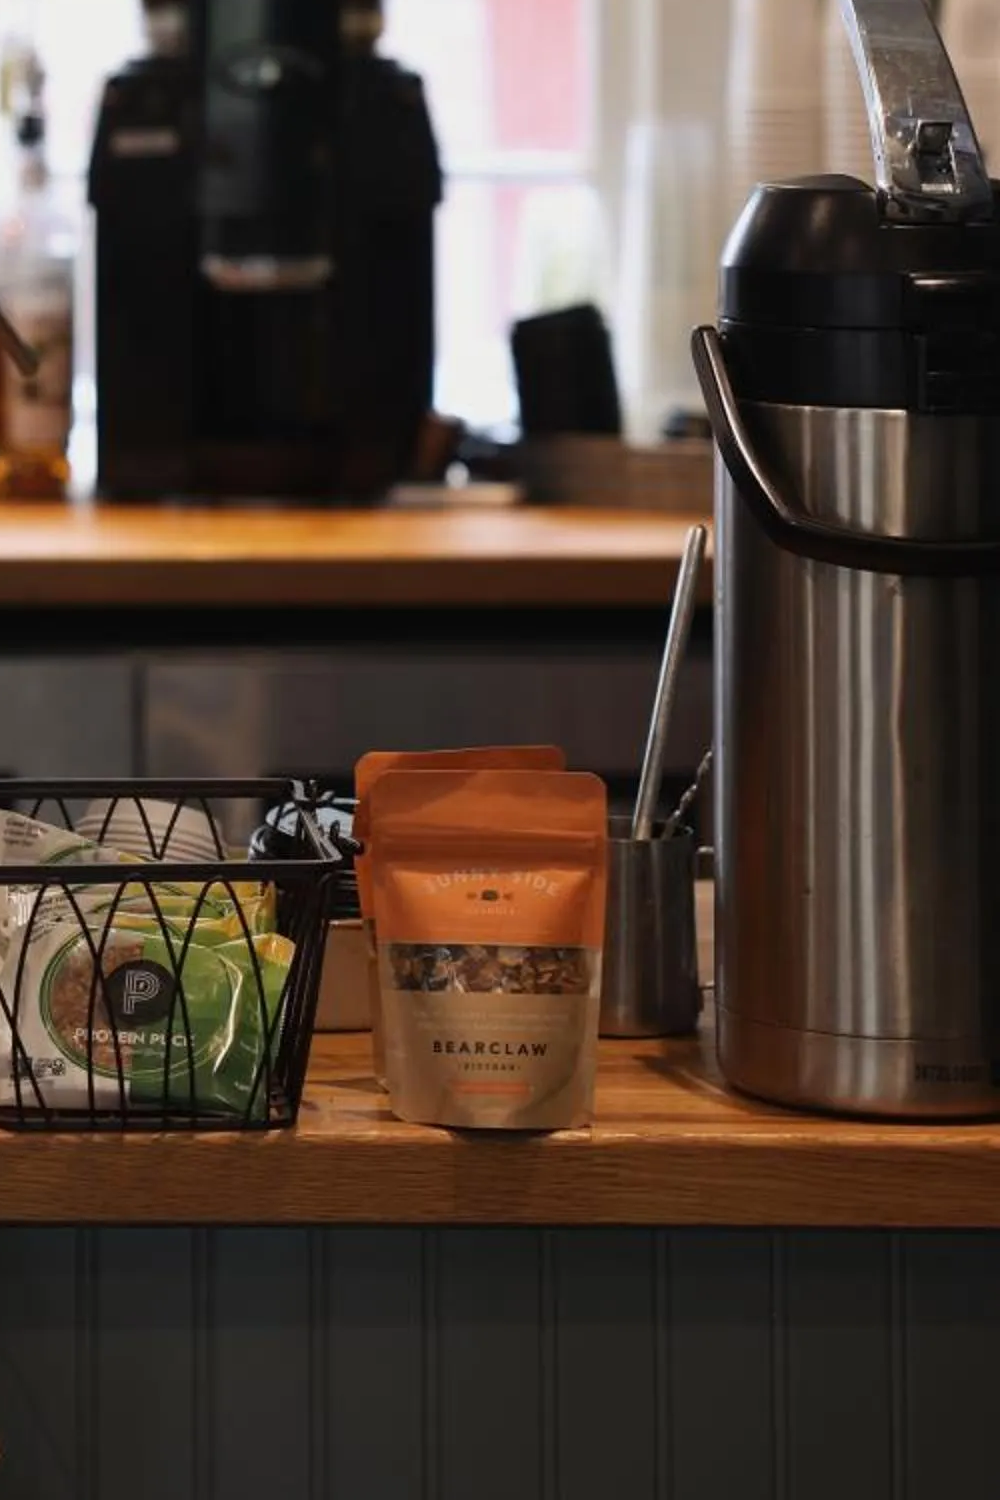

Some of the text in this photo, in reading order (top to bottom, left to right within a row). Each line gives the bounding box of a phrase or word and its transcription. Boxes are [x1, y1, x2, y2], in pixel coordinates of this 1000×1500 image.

[510, 869, 561, 898] SIDE
[74, 1027, 145, 1044] POEIN
[432, 1039, 548, 1056] BEARCLAW
